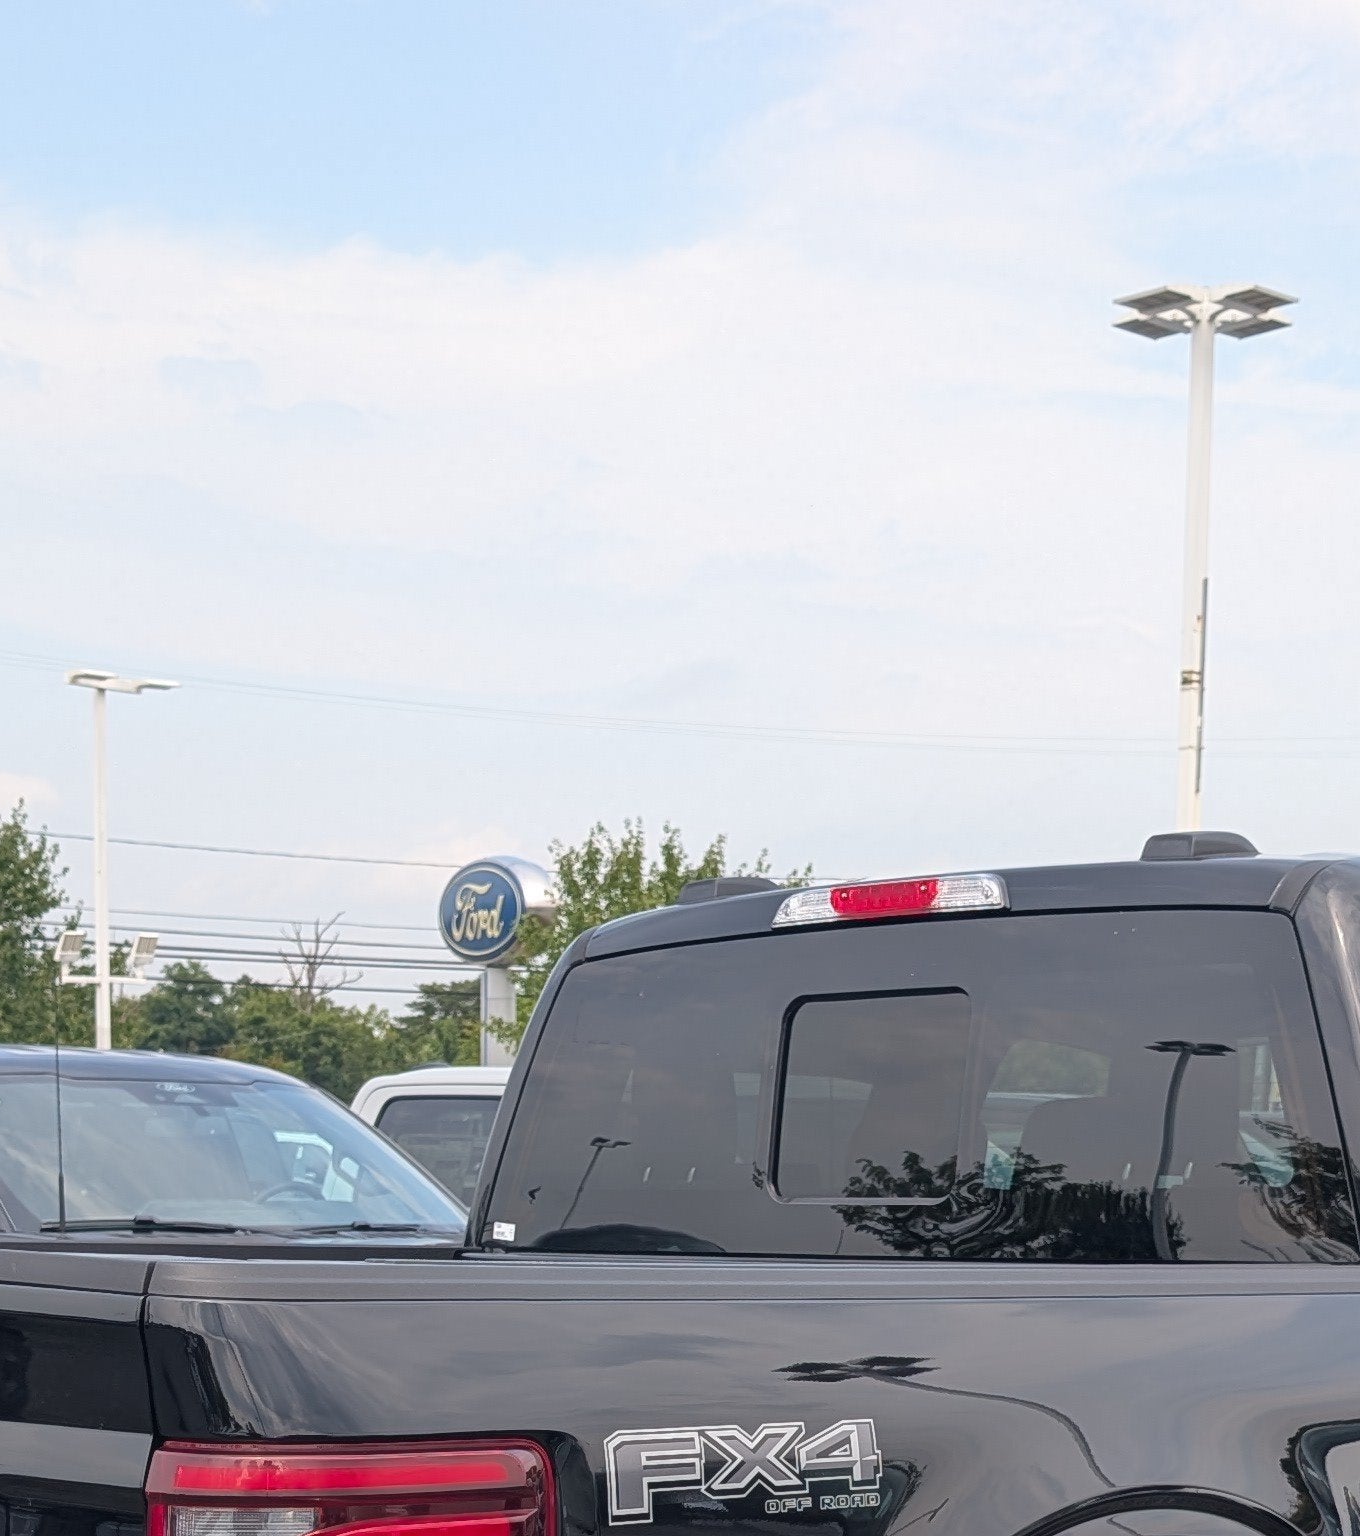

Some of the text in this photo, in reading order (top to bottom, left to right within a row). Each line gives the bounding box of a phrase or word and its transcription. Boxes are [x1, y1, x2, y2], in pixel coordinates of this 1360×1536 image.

[451, 882, 505, 941] Ford
[603, 1418, 883, 1527] FX4
[764, 1492, 881, 1514] OFF ROAD
